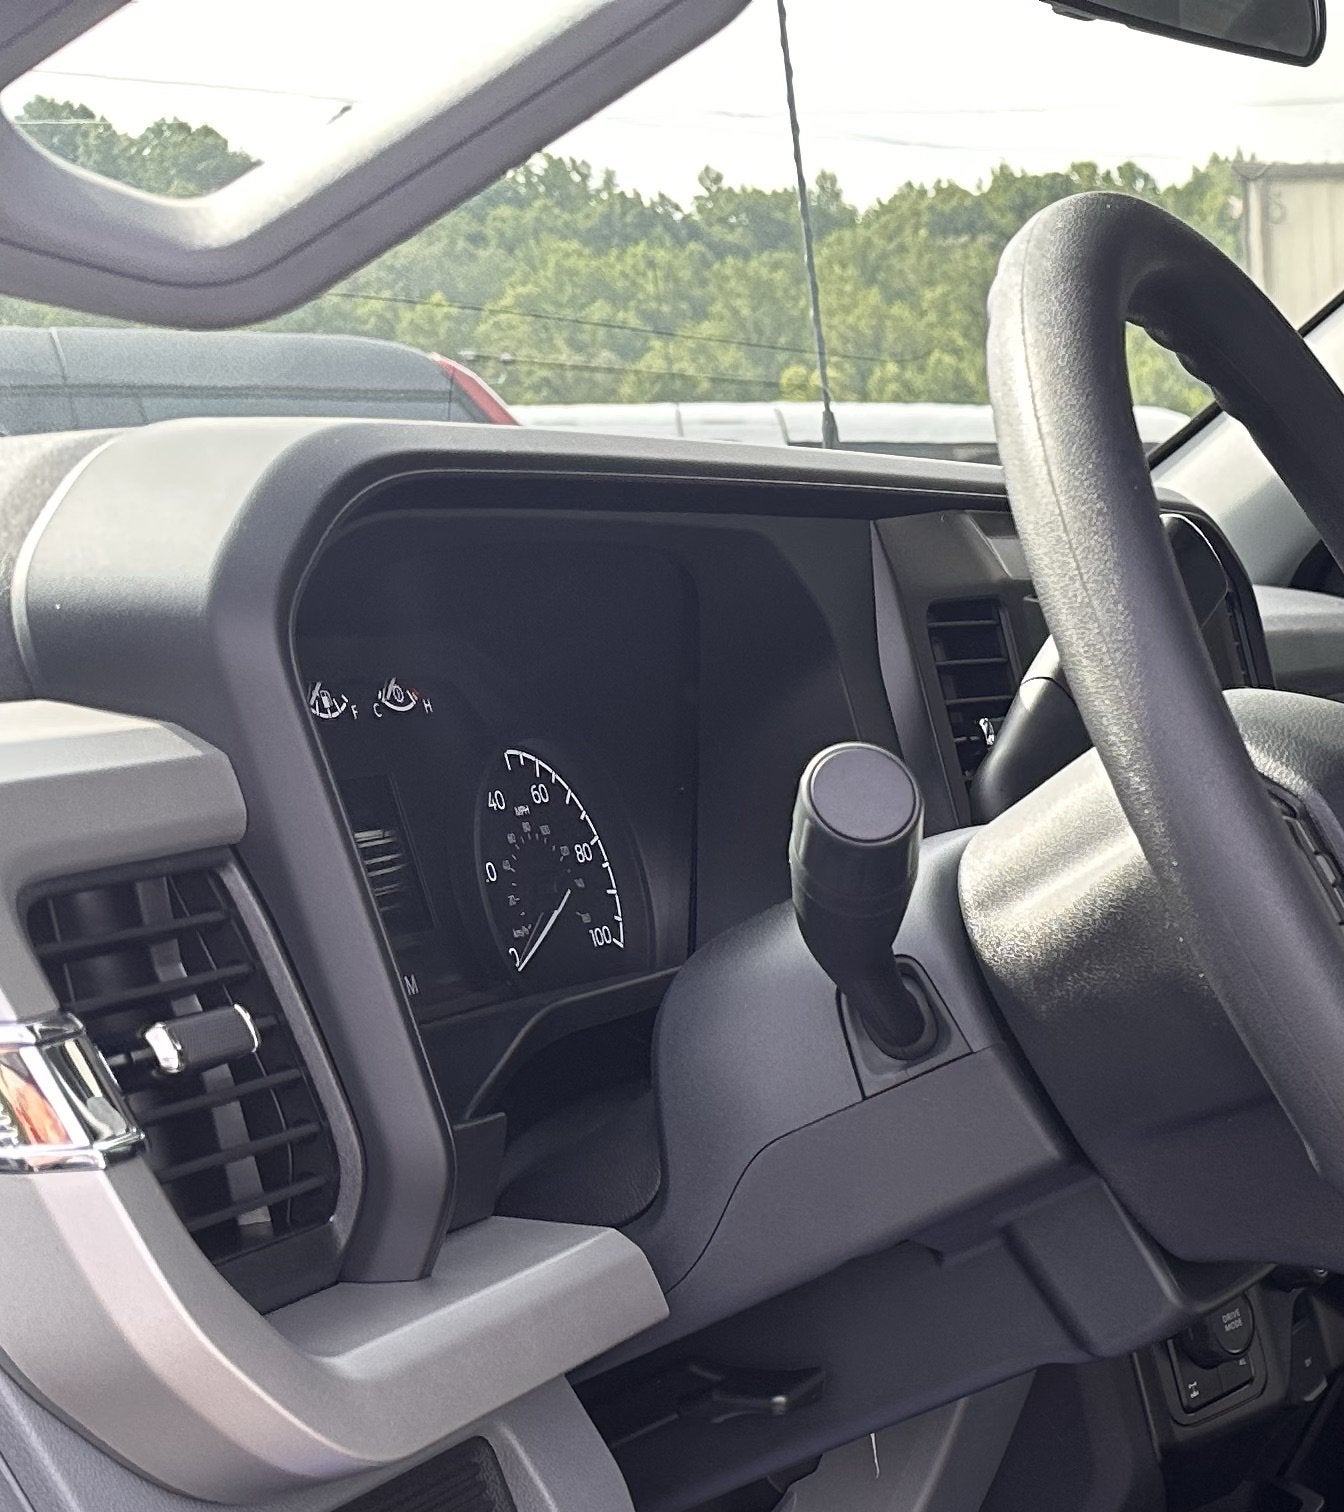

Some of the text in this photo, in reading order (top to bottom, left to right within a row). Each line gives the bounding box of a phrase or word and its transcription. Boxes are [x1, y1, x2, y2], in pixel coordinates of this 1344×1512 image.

[351, 704, 359, 720] F
[373, 702, 383, 718] C
[422, 698, 434, 714] H
[488, 790, 506, 811] 40
[530, 783, 549, 804] 60
[574, 842, 593, 863] 80
[588, 925, 612, 947] 100
[403, 974, 419, 996] M
[1221, 1308, 1241, 1324] DRIVE
[1224, 1317, 1243, 1332] MODE
